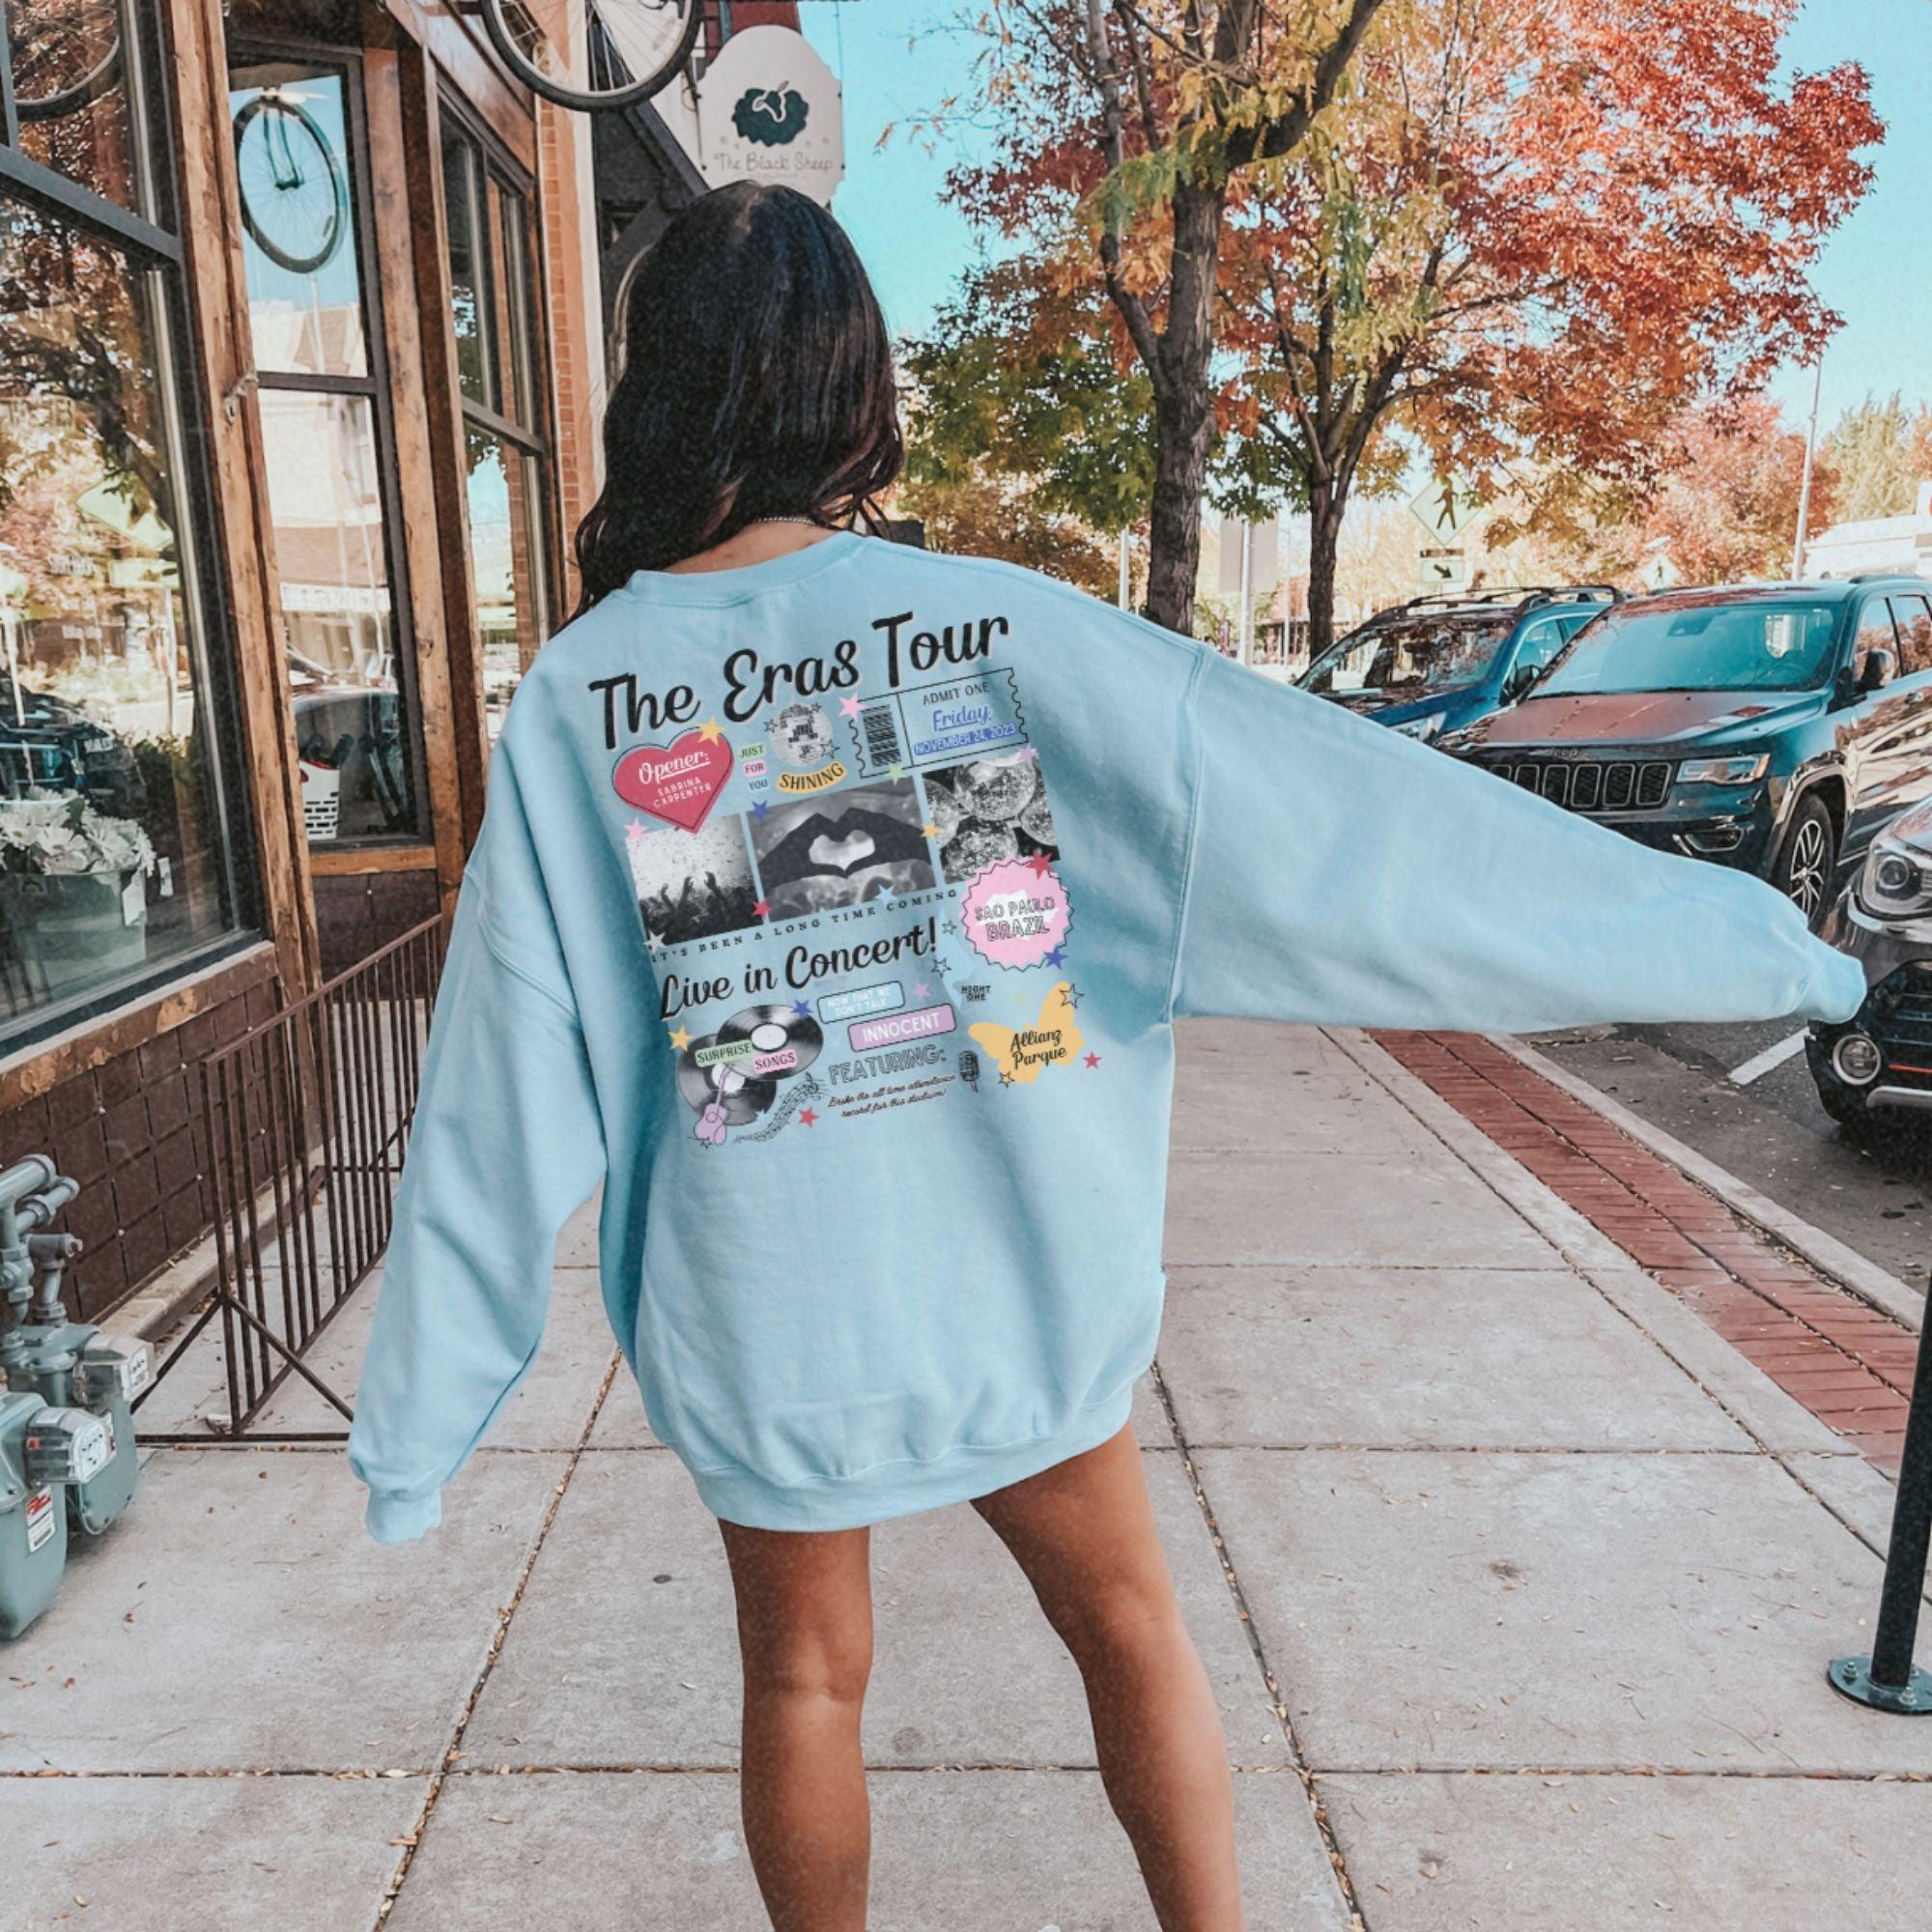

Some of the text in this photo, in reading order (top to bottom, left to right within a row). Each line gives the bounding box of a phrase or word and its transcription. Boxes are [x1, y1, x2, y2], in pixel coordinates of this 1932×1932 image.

[715, 152, 834, 172] The Black Sheep
[587, 611, 1009, 750] The Eras Tour
[923, 682, 990, 706] ADMIT ONE
[915, 732, 971, 754] NOVEMBER
[990, 723, 1017, 738] 2023
[739, 744, 764, 758] JUST
[639, 752, 711, 785] Opener:
[745, 762, 765, 774] FOR
[779, 761, 844, 791] SHINING
[653, 782, 712, 809] CARPENTER
[658, 776, 702, 797] SABRINA
[748, 778, 769, 790] YOU
[1007, 895, 1056, 917] PAULO
[651, 889, 957, 963] IT'S BEEN A LONG TIME COMING
[985, 915, 1051, 942] BRAZIL
[661, 916, 936, 1020] Live in Concert!
[966, 993, 986, 1003] ONE
[862, 1011, 941, 1044] INNOCENT
[696, 1042, 752, 1064] SURPRISE
[1009, 1029, 1062, 1053] Allianz
[753, 1052, 796, 1070] SONGS
[828, 1044, 947, 1085] FEATURING:
[1011, 1047, 1066, 1070] Parque
